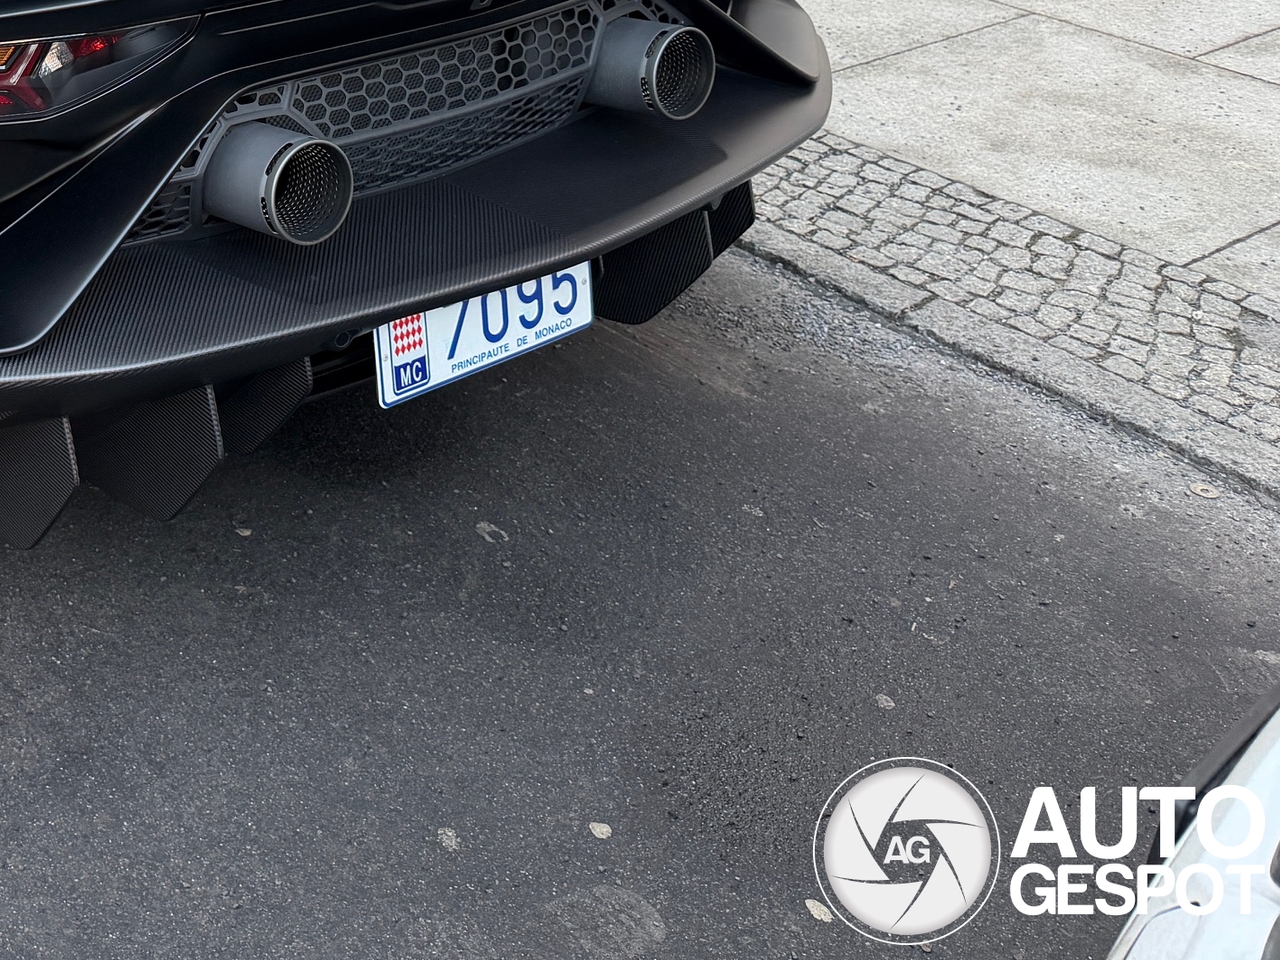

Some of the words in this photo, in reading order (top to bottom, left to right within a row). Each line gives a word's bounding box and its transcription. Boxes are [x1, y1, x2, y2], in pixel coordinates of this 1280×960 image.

[451, 343, 510, 374] PRINCIPAUTE
[517, 335, 528, 348] DE
[534, 317, 572, 340] MONACO
[400, 363, 423, 387] MC
